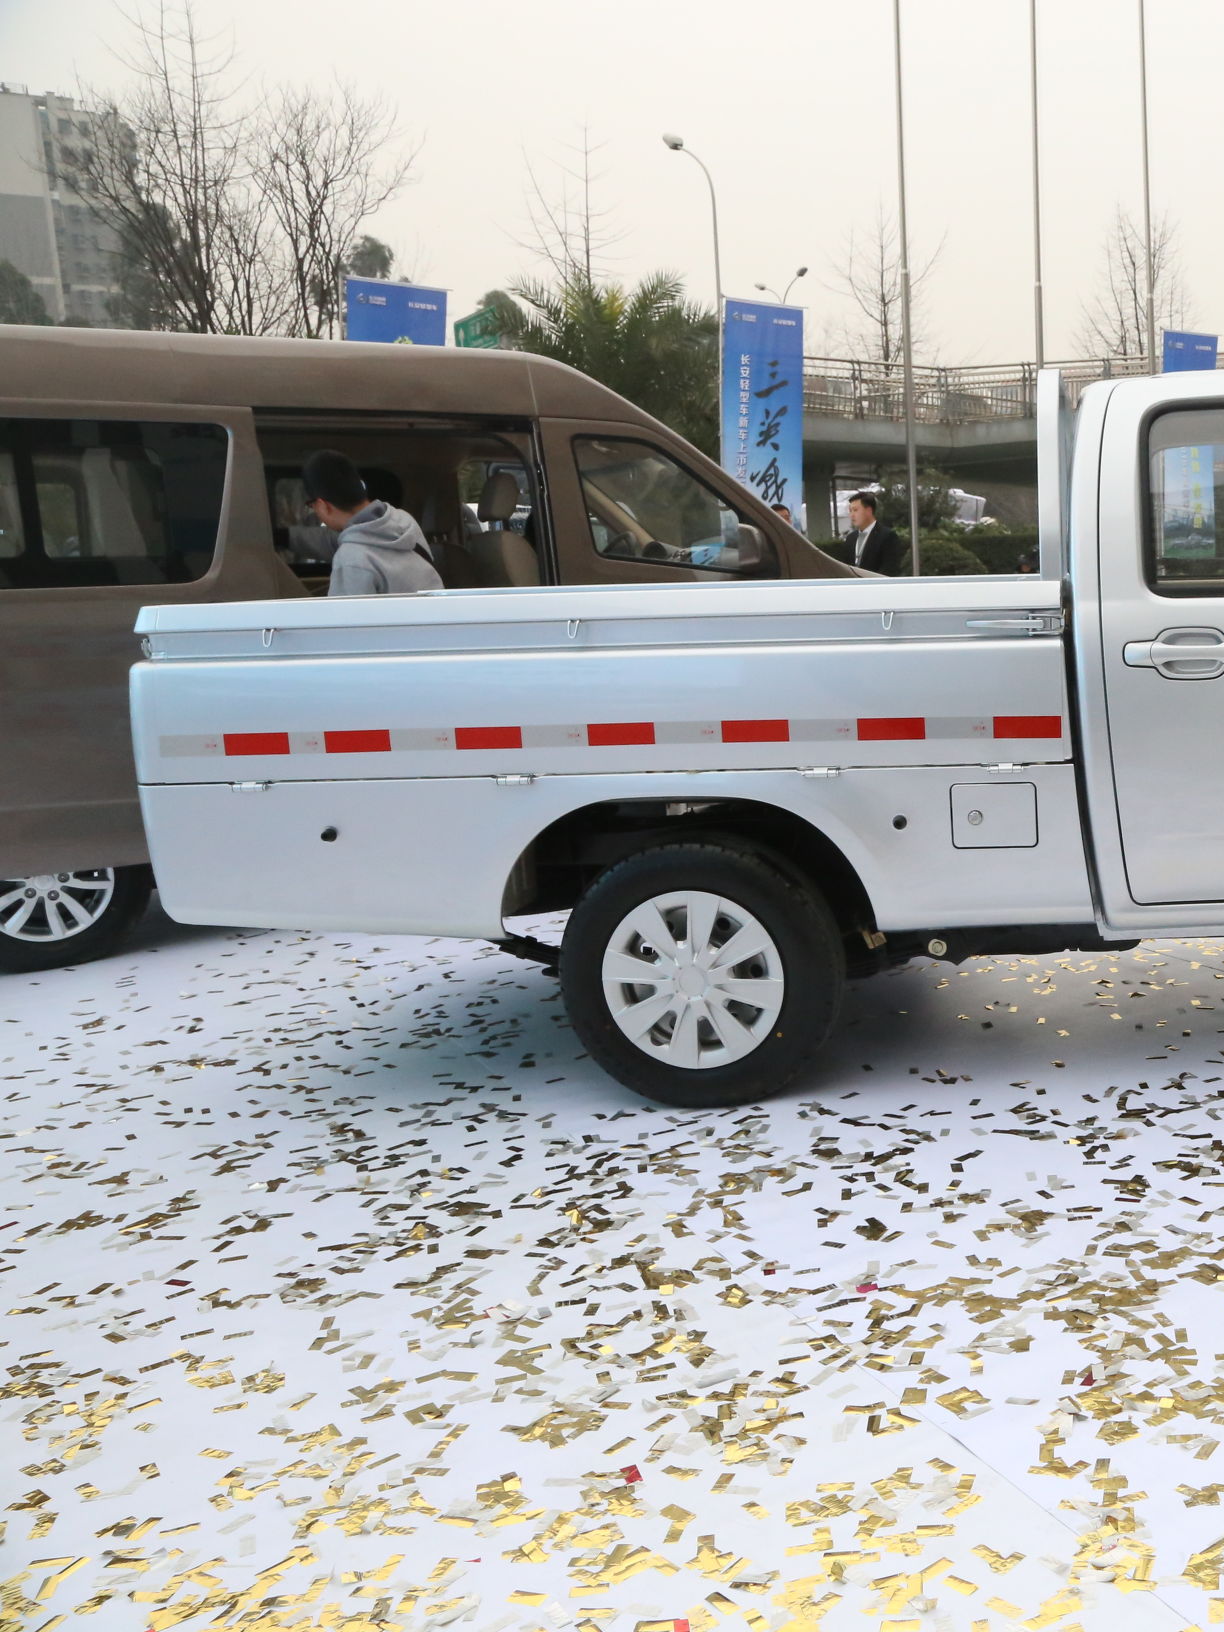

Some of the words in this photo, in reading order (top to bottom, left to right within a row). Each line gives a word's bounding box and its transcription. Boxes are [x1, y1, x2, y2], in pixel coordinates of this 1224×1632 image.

[736, 354, 751, 487] 长安轻型车新车上市发
